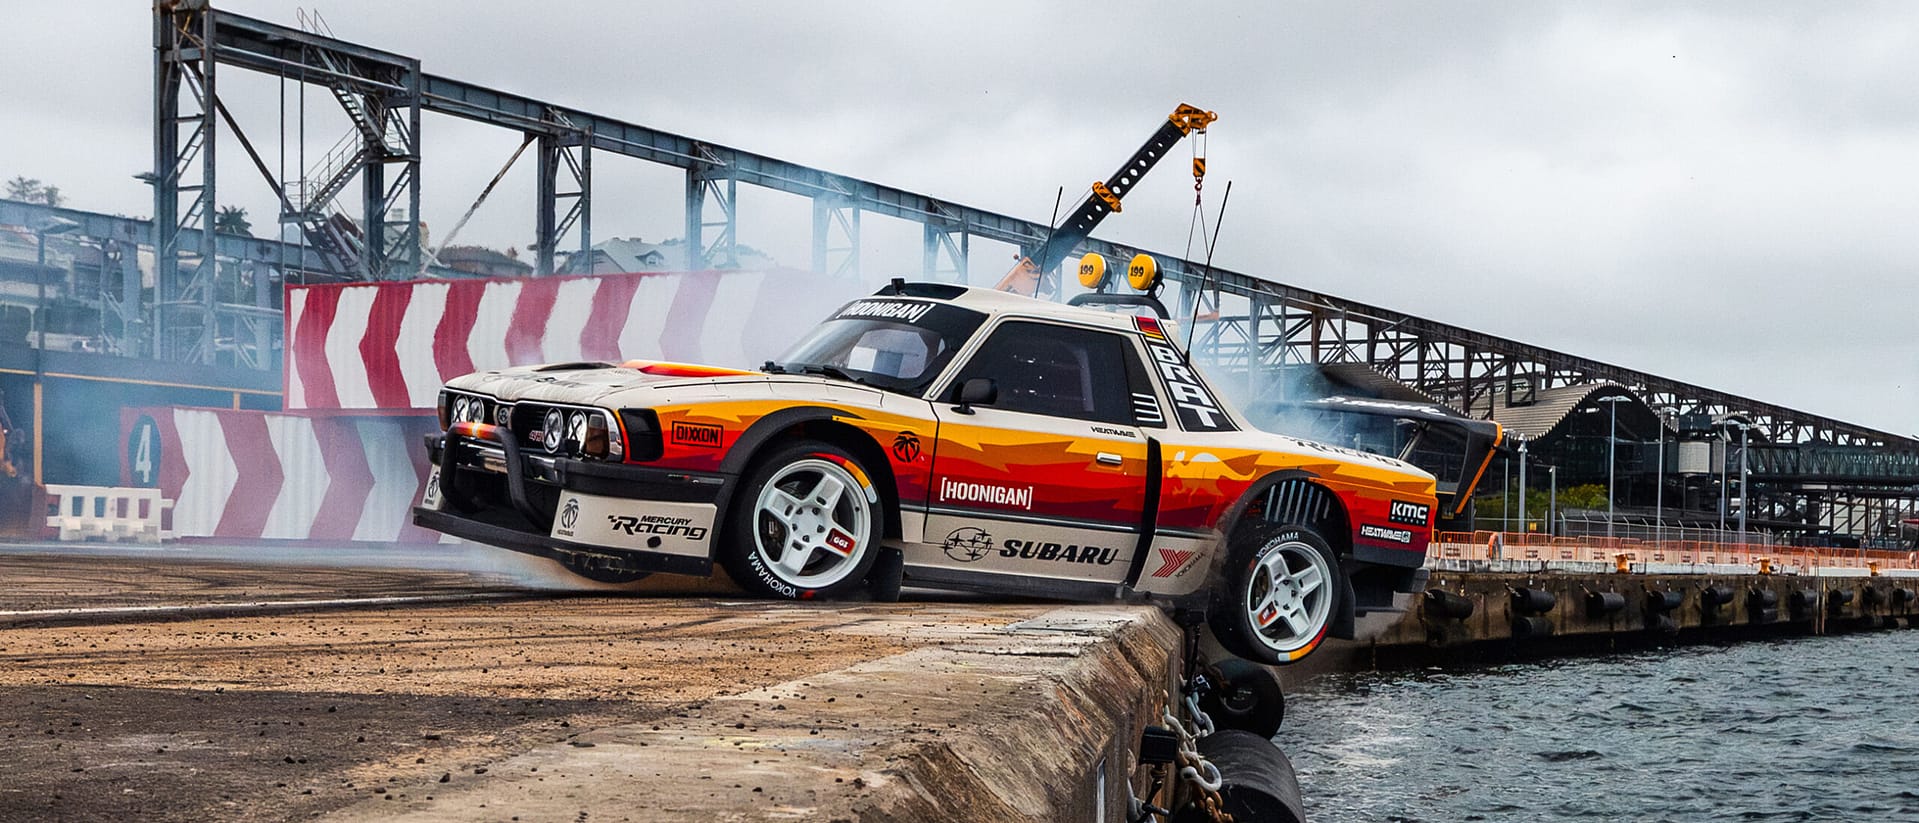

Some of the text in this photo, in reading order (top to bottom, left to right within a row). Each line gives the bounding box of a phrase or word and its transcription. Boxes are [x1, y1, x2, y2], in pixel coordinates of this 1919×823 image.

[1080, 265, 1094, 275] 199
[1130, 266, 1144, 277] 199
[1150, 345, 1220, 428] BRAT
[676, 425, 719, 444] DIXXON
[135, 424, 151, 483] 4
[611, 516, 708, 541] Racing
[641, 515, 692, 526] MERCURY
[1000, 538, 1119, 565] SUBARU
[1256, 531, 1300, 559] YOKOHAMA
[748, 551, 797, 598] YOKOHAMA
